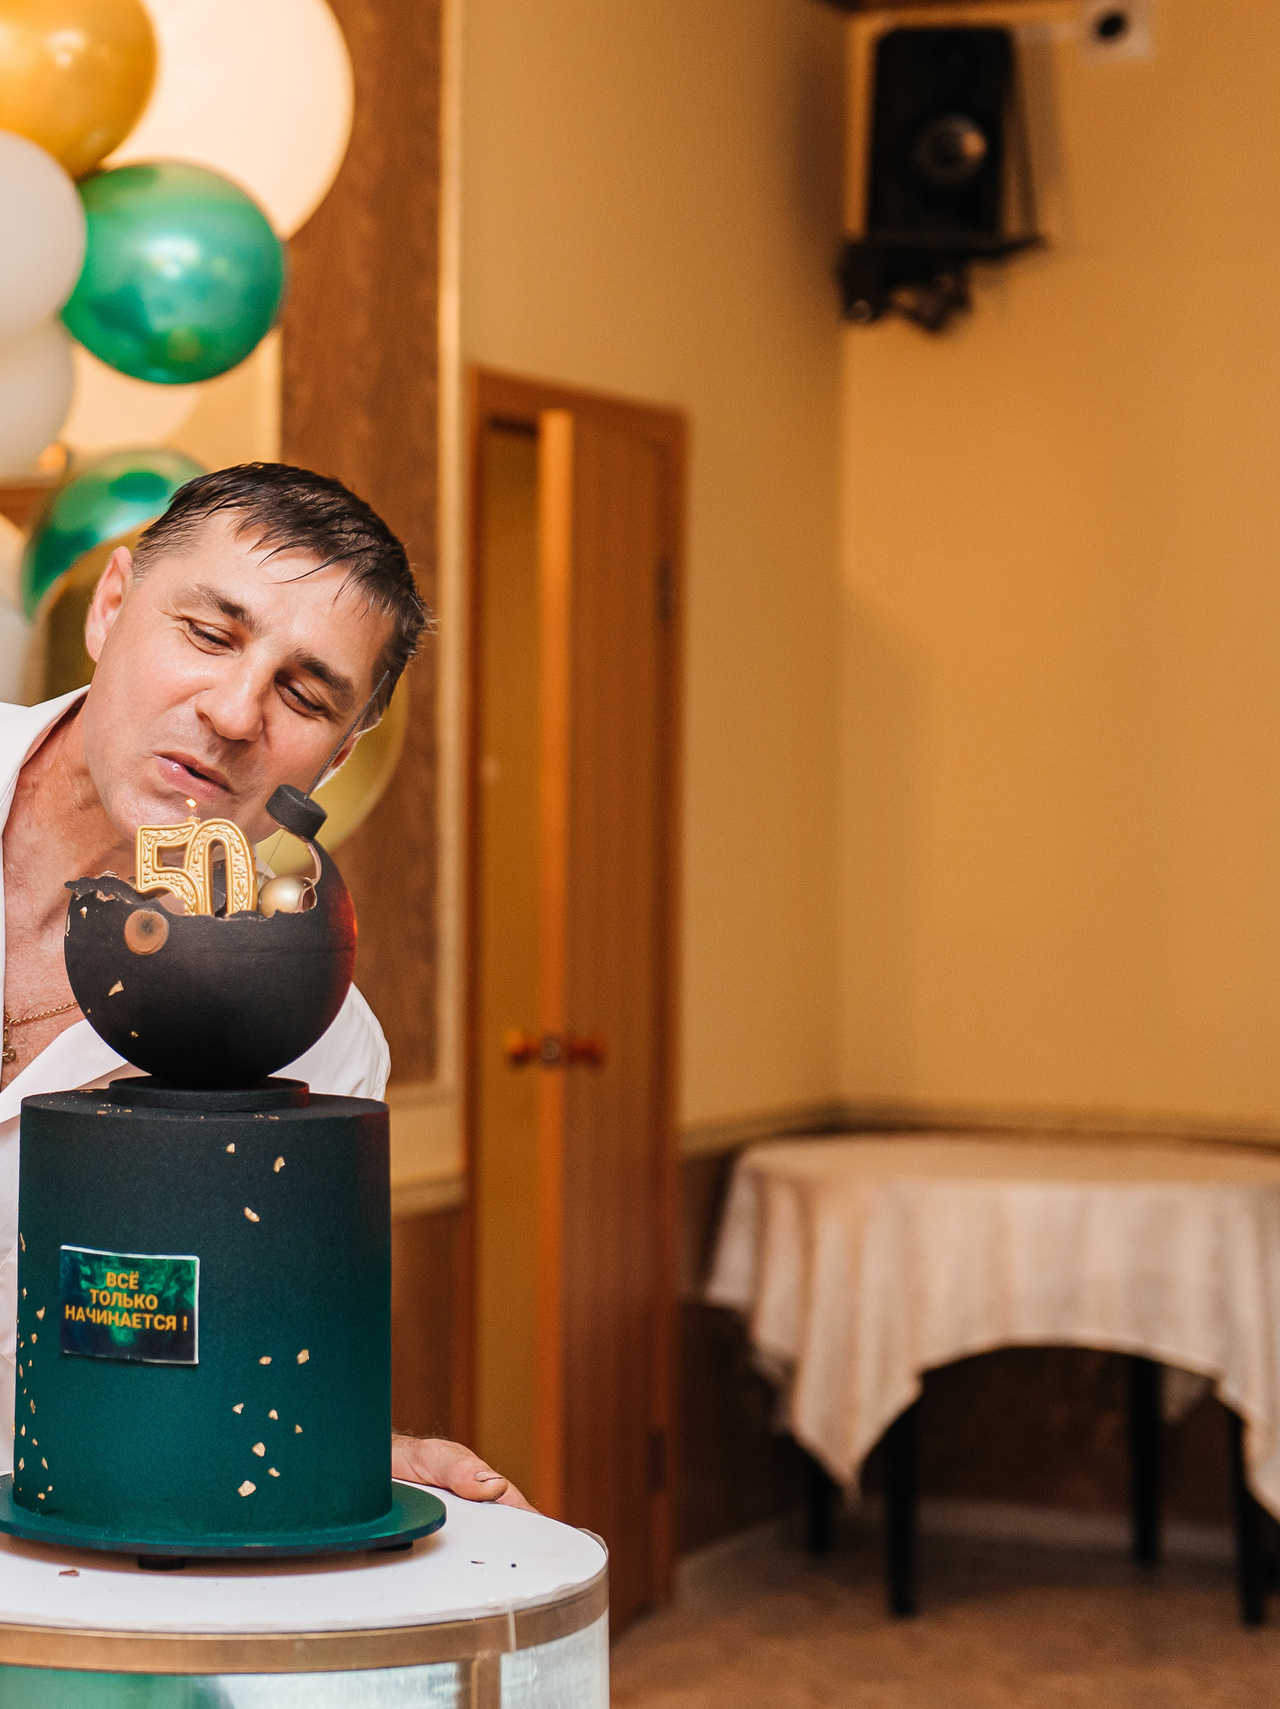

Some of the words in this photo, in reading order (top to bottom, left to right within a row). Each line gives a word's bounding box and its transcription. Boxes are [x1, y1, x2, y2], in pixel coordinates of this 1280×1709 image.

[135, 817, 257, 917] 50
[106, 1271, 139, 1289] ВСЁ
[90, 1289, 158, 1310] ТОЛЬКО
[64, 1304, 177, 1331] НАЧИНАЕТСЯ
